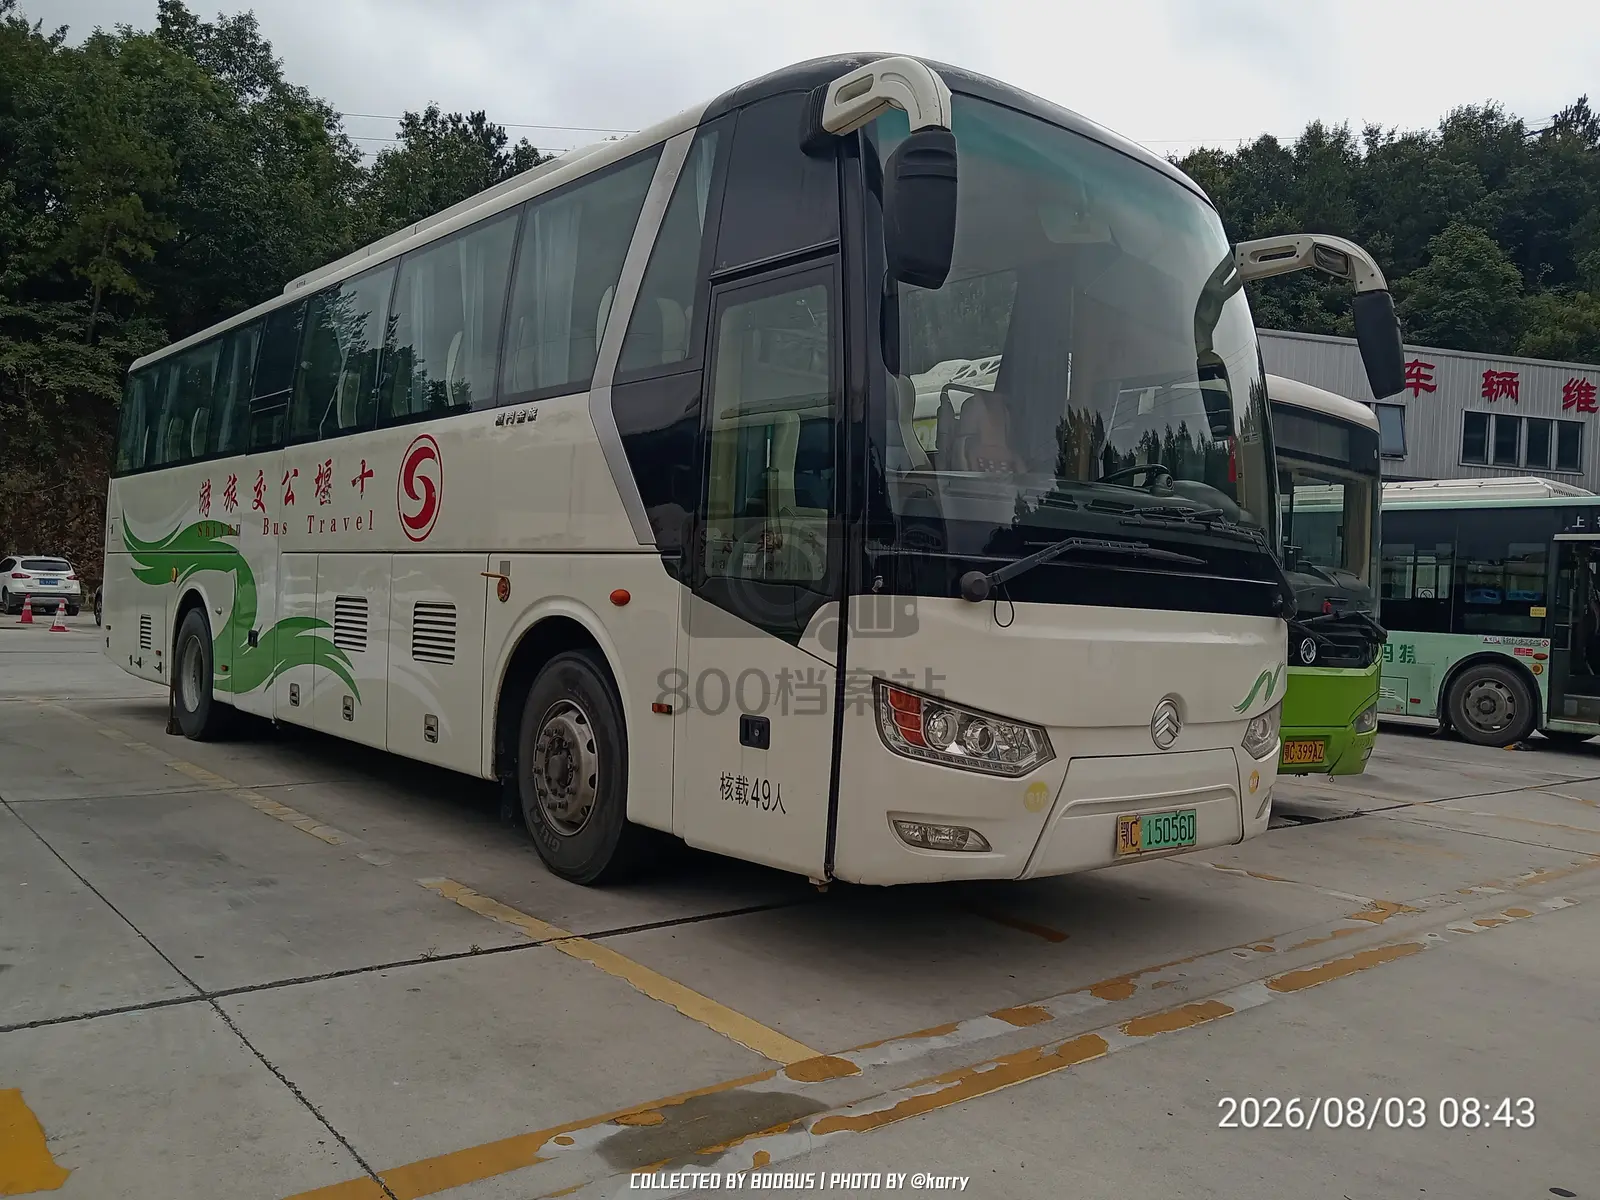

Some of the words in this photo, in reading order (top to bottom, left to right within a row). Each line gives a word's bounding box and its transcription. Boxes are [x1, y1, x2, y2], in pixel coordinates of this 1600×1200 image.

[263, 517, 288, 536] Bus
[307, 510, 373, 534] Travel
[719, 771, 787, 815] 核载49人
